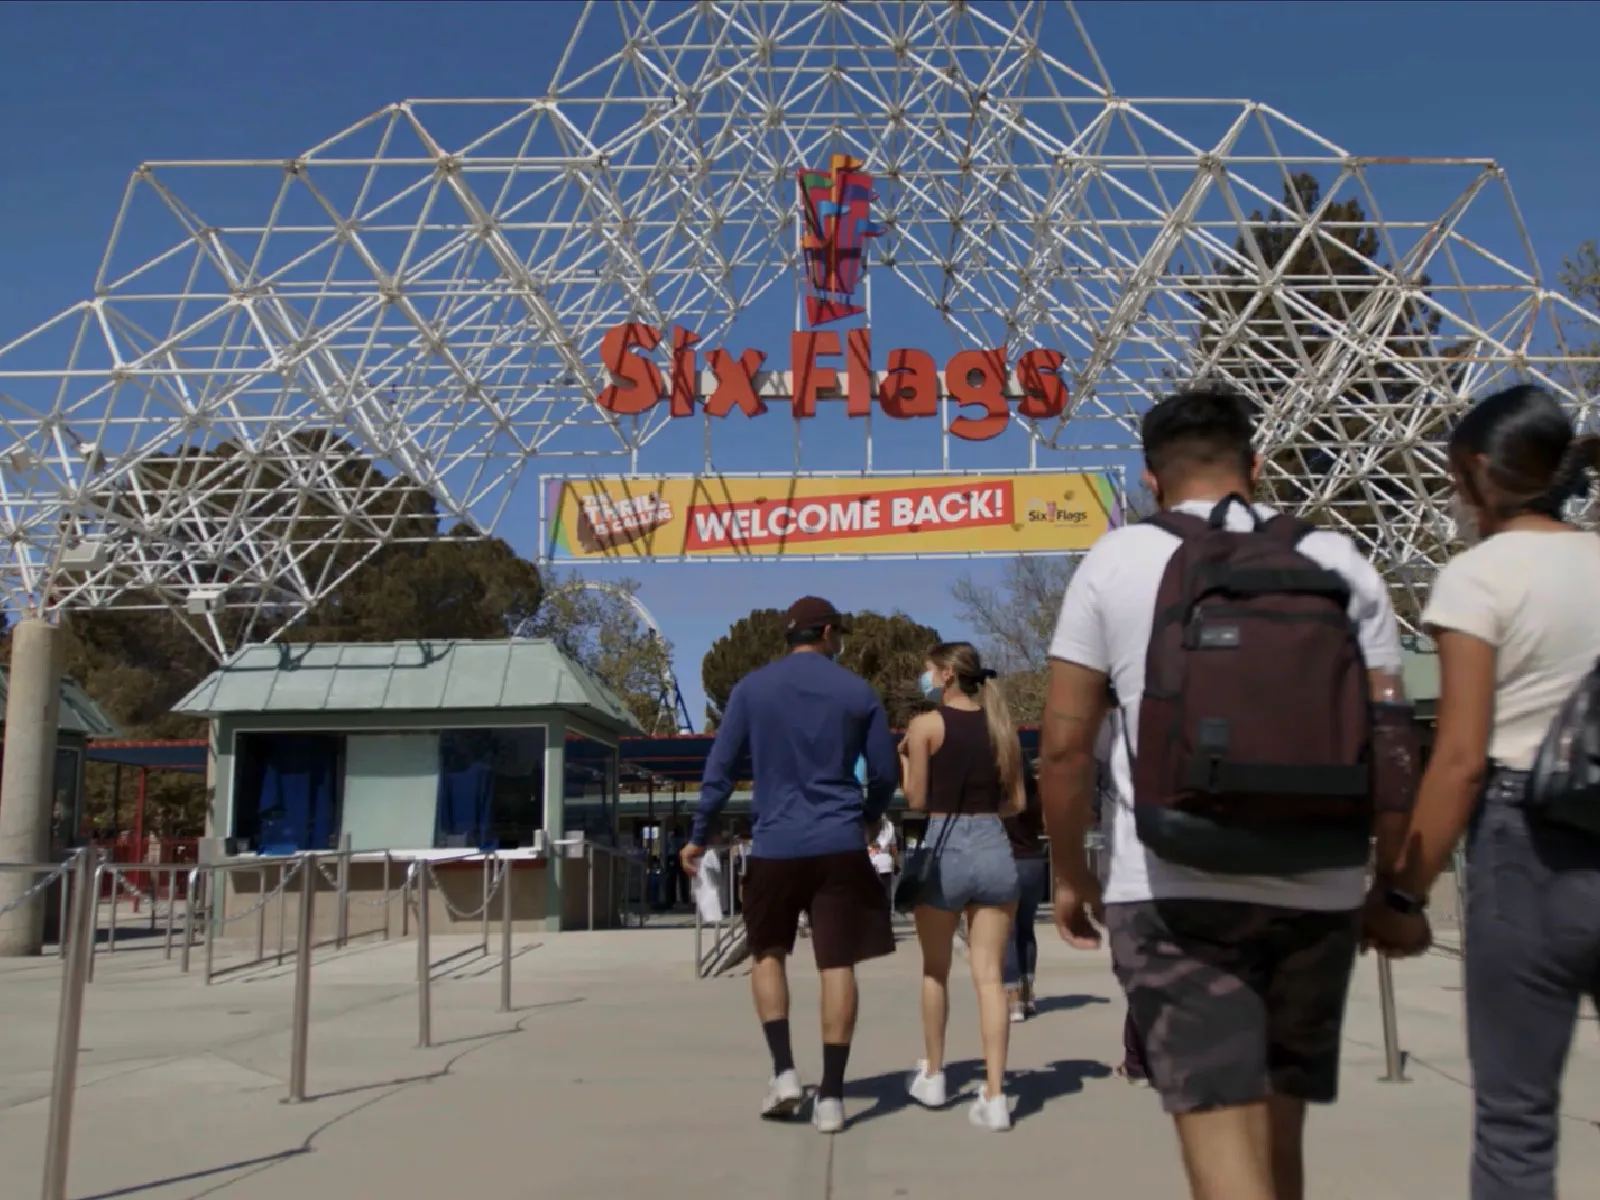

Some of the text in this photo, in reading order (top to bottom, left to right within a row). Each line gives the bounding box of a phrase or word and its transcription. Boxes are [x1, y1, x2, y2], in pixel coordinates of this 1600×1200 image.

[599, 322, 1067, 441] Six Flags
[695, 488, 1003, 542] WELCOME BACK!
[1028, 509, 1088, 523] Six Flags
